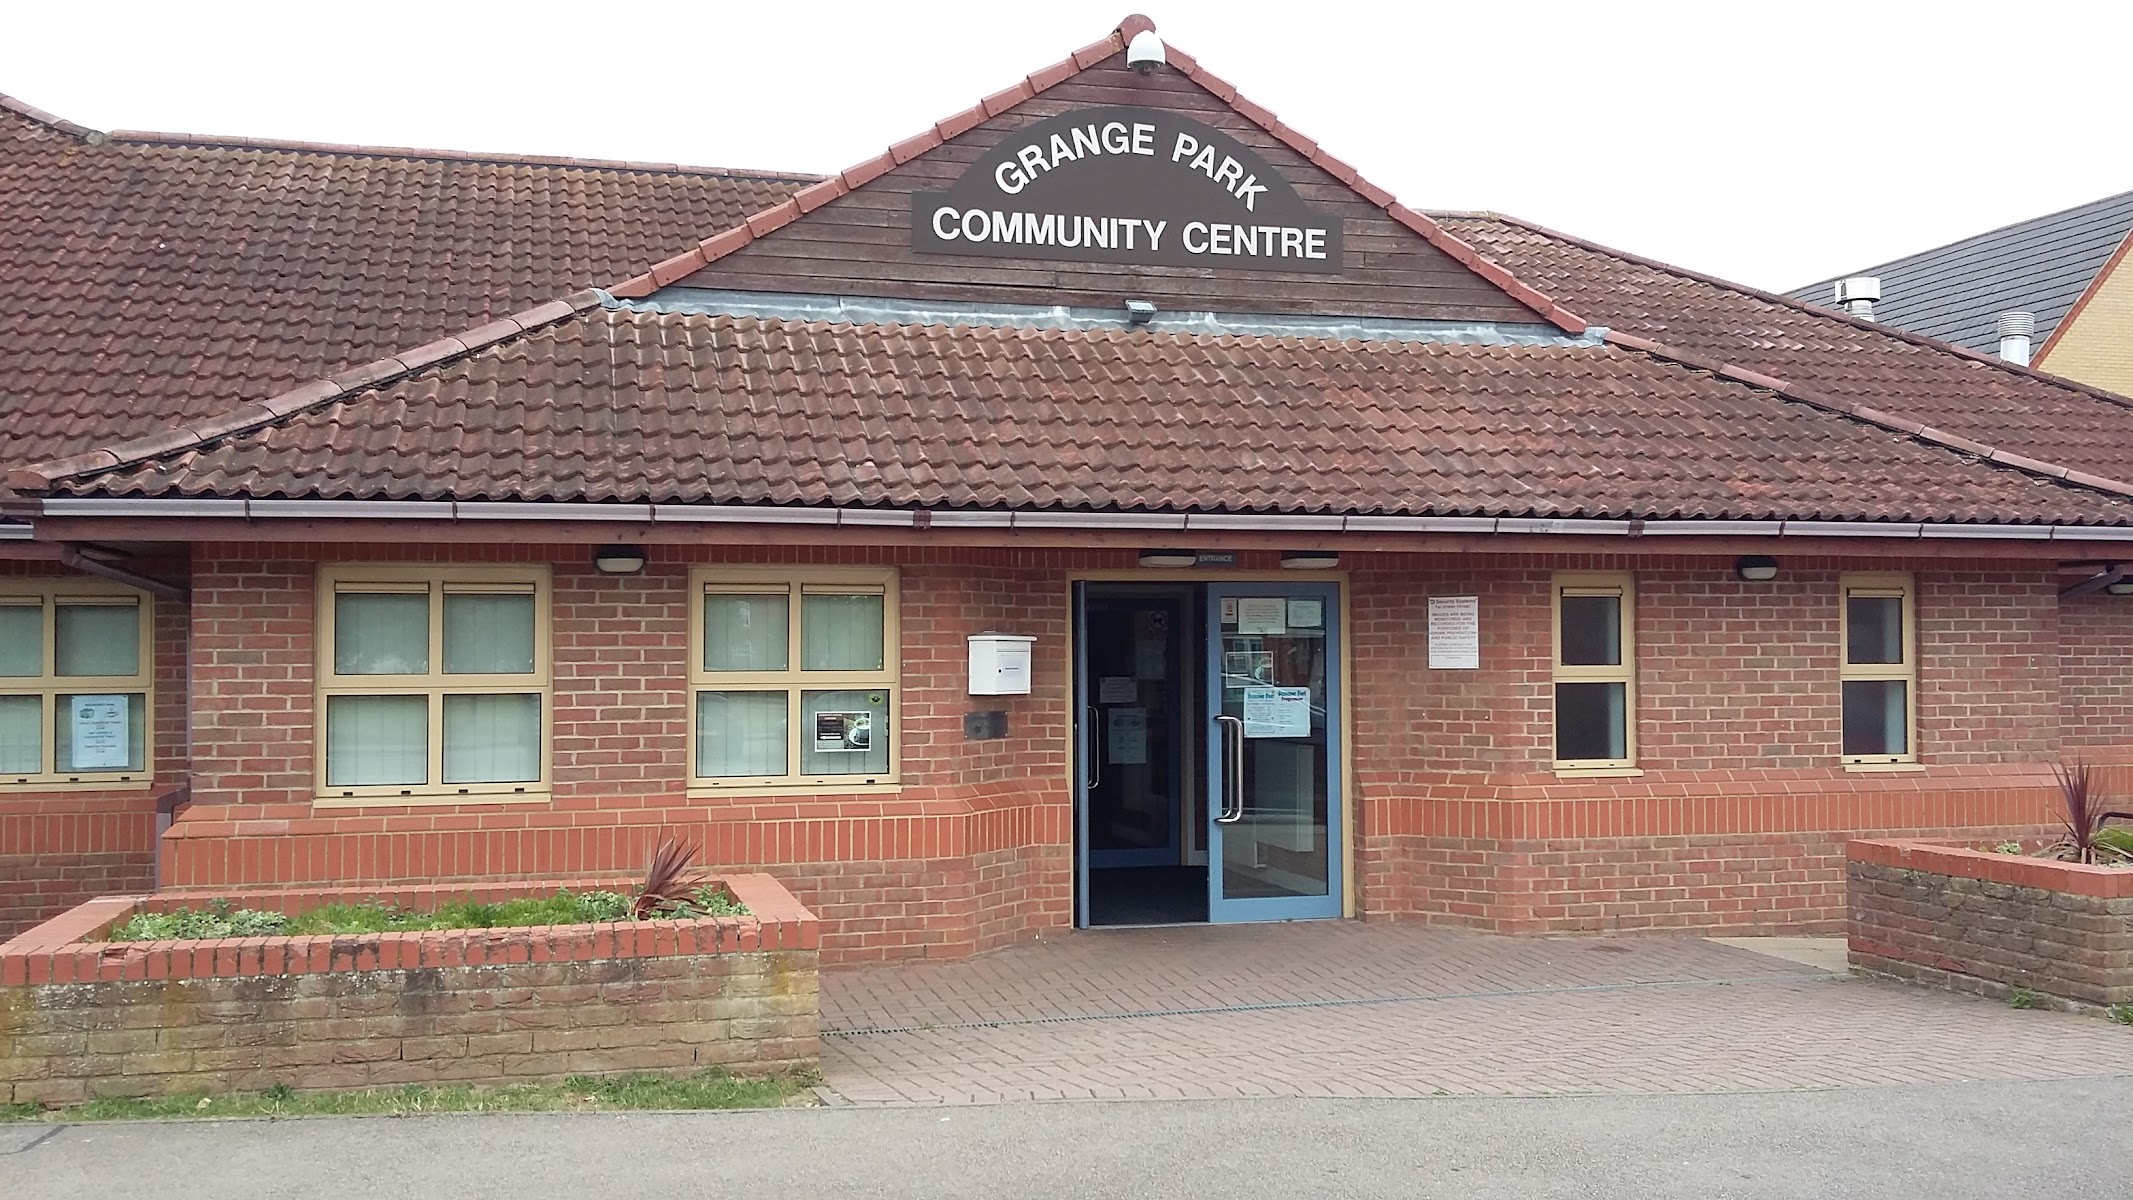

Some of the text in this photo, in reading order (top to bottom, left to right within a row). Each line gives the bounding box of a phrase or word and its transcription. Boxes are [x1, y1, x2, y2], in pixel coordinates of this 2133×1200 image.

[994, 121, 1268, 212] GRANGE PARK
[932, 206, 1328, 260] COMMUNITY CENTRE
